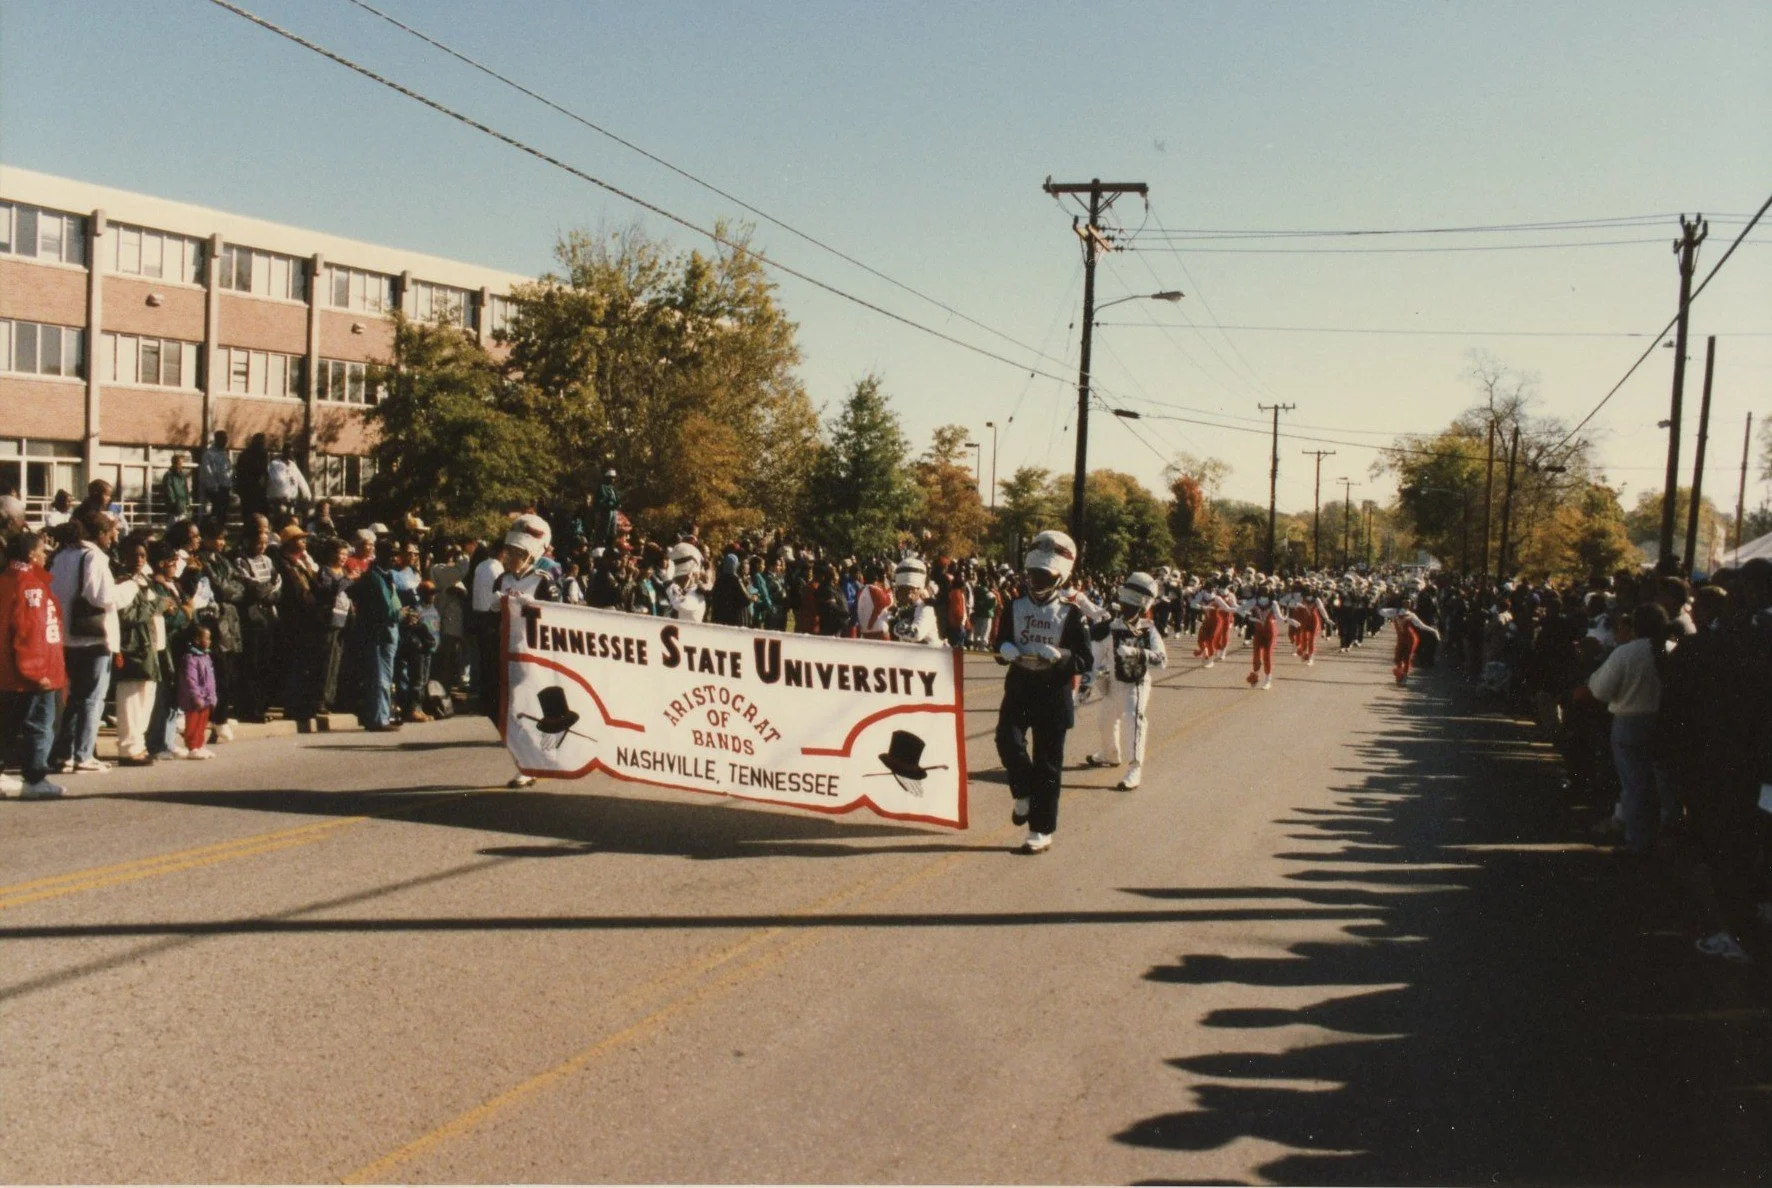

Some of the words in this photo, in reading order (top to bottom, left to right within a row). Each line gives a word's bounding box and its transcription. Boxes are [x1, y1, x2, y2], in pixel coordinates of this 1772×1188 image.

[521, 605, 648, 666] TENNESSEE
[660, 625, 741, 678] STATE
[754, 638, 937, 697] UNIVERSITY
[663, 685, 781, 743] ARISTOCRAT
[707, 709, 730, 728] OF
[692, 730, 755, 756] BANDS
[617, 747, 720, 784] NASHVILLE,
[729, 762, 839, 797] TENNESSEE
